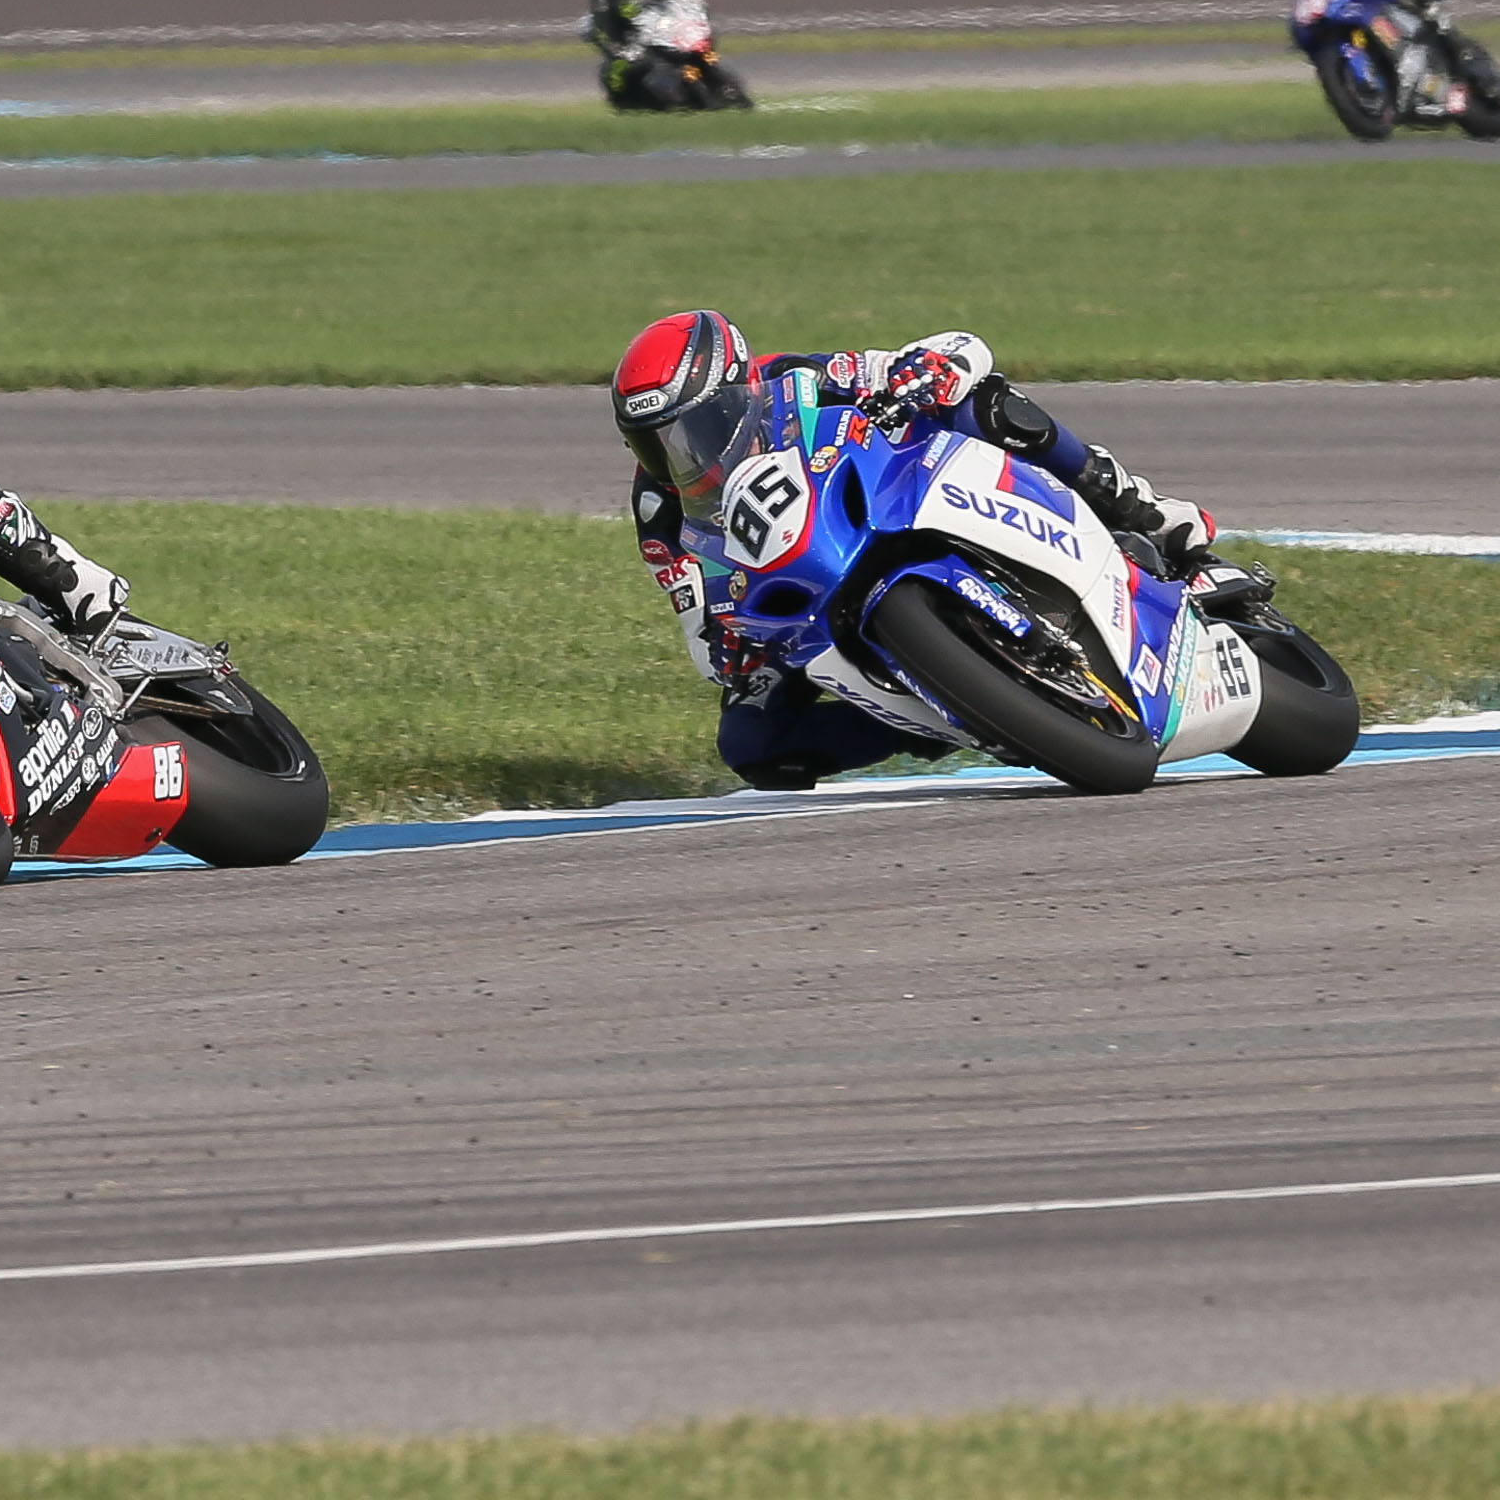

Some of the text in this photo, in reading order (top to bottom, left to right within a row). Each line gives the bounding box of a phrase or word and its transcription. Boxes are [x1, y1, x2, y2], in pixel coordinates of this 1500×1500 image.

[628, 395, 659, 413] SHOEI
[730, 464, 802, 561] 85
[941, 483, 1083, 562] SUZUKI
[18, 716, 69, 787] aprilia
[27, 731, 86, 817] DUNLOP
[153, 744, 184, 800] 86
